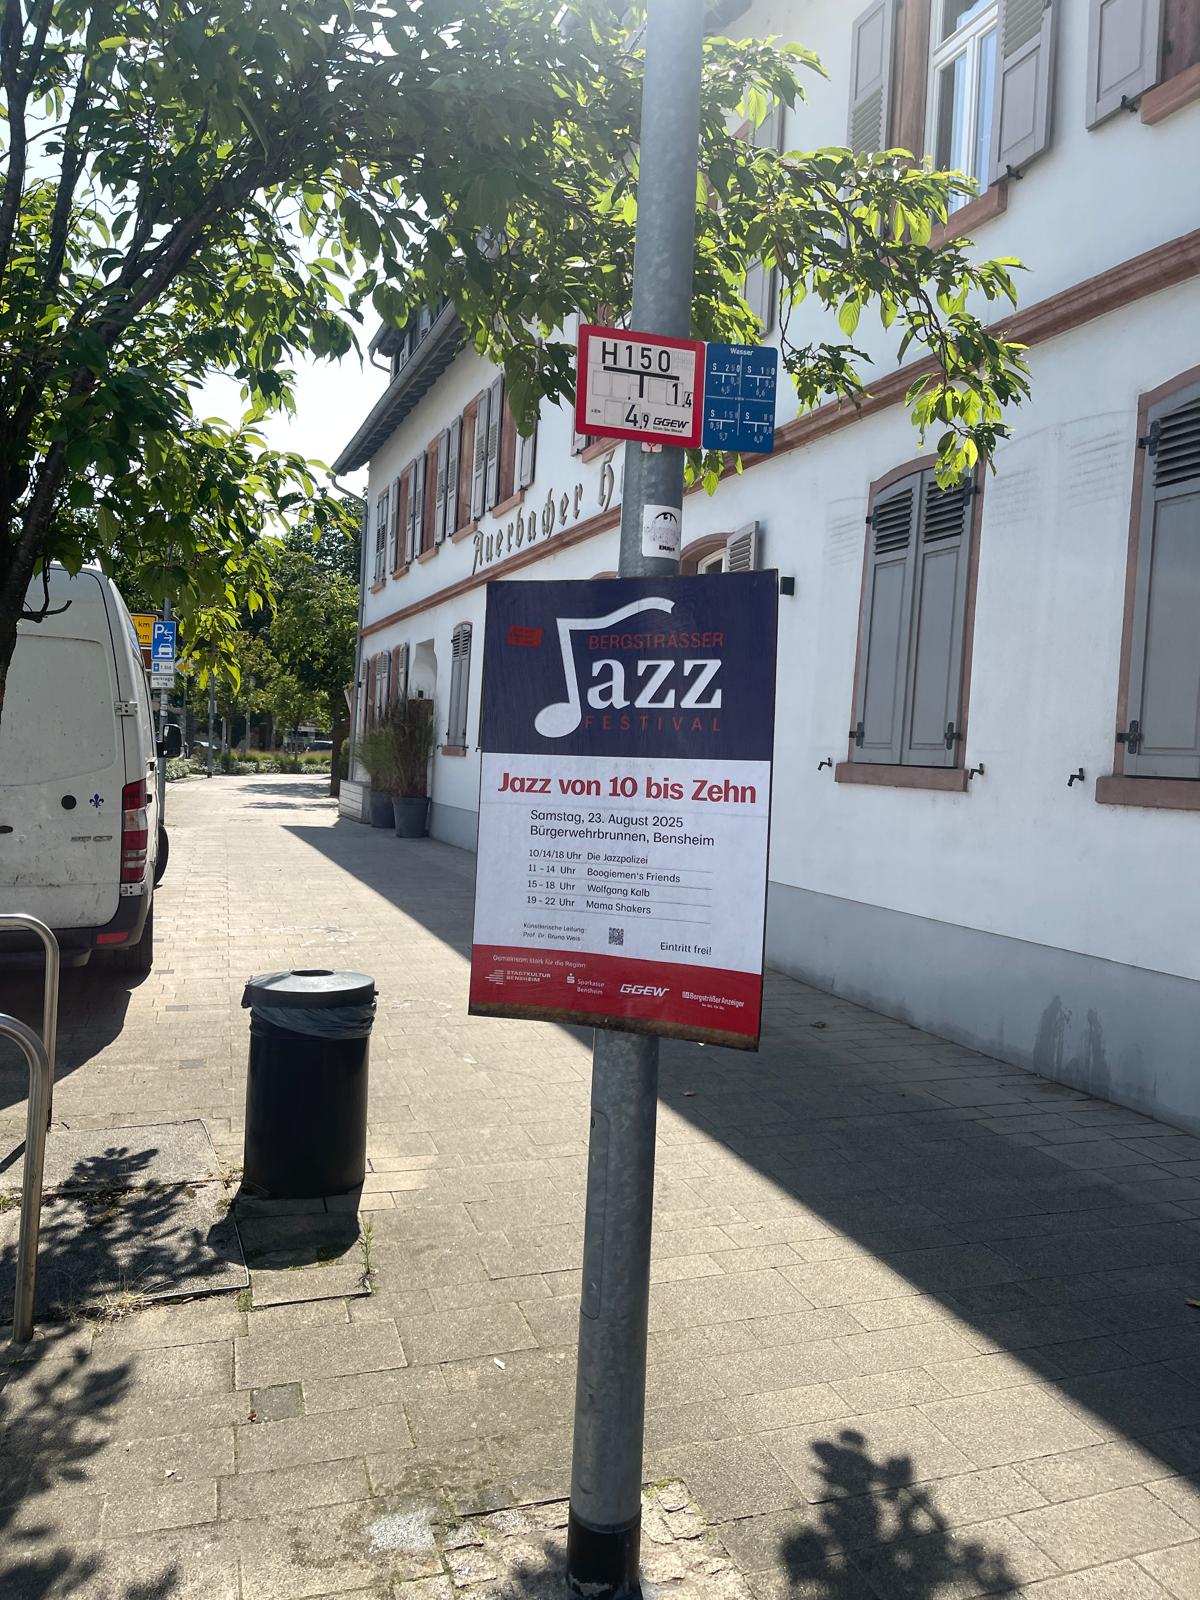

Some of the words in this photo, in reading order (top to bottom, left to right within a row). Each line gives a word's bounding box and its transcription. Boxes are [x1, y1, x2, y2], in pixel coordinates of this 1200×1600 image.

[601, 341, 671, 373] H150
[730, 347, 754, 356] Wasser
[653, 417, 689, 429] GGEW
[154, 624, 165, 639] P
[584, 715, 721, 731] FESTIVAL
[498, 772, 551, 793] Jazz
[559, 779, 601, 796] von
[608, 776, 637, 798] 10
[645, 776, 684, 800] bis
[691, 779, 756, 804] Zehn
[530, 809, 585, 825] Samstag,
[588, 812, 605, 824] 23.
[608, 814, 649, 827] August
[652, 816, 683, 828] 2025
[530, 825, 650, 844] Bürgerwehrbrunnen,
[653, 832, 715, 847] Bensheim
[529, 849, 564, 859] 10/14/18
[566, 851, 582, 860] Uhr
[587, 852, 601, 861] Die
[603, 853, 648, 864] Jazzpolizei
[528, 864, 536, 872] 11
[546, 865, 555, 873] 14
[560, 866, 576, 874] Uhr
[587, 867, 644, 879] Boogiemen's
[646, 872, 681, 883] Friends
[528, 880, 537, 888] 15
[545, 881, 555, 889] 18
[559, 882, 576, 891] Uhr
[587, 884, 628, 897] Wolfgang
[630, 887, 650, 897] Kalb
[527, 896, 537, 904] 19
[545, 897, 556, 905] 22
[559, 898, 575, 907] Uhr
[586, 900, 613, 910] Mama
[615, 902, 651, 914] Shakers
[660, 941, 691, 953] Eintritt
[694, 945, 712, 955] frei!
[577, 978, 605, 988] Sparkasse
[577, 986, 603, 995] Bensheim
[620, 983, 670, 997] GGEW
